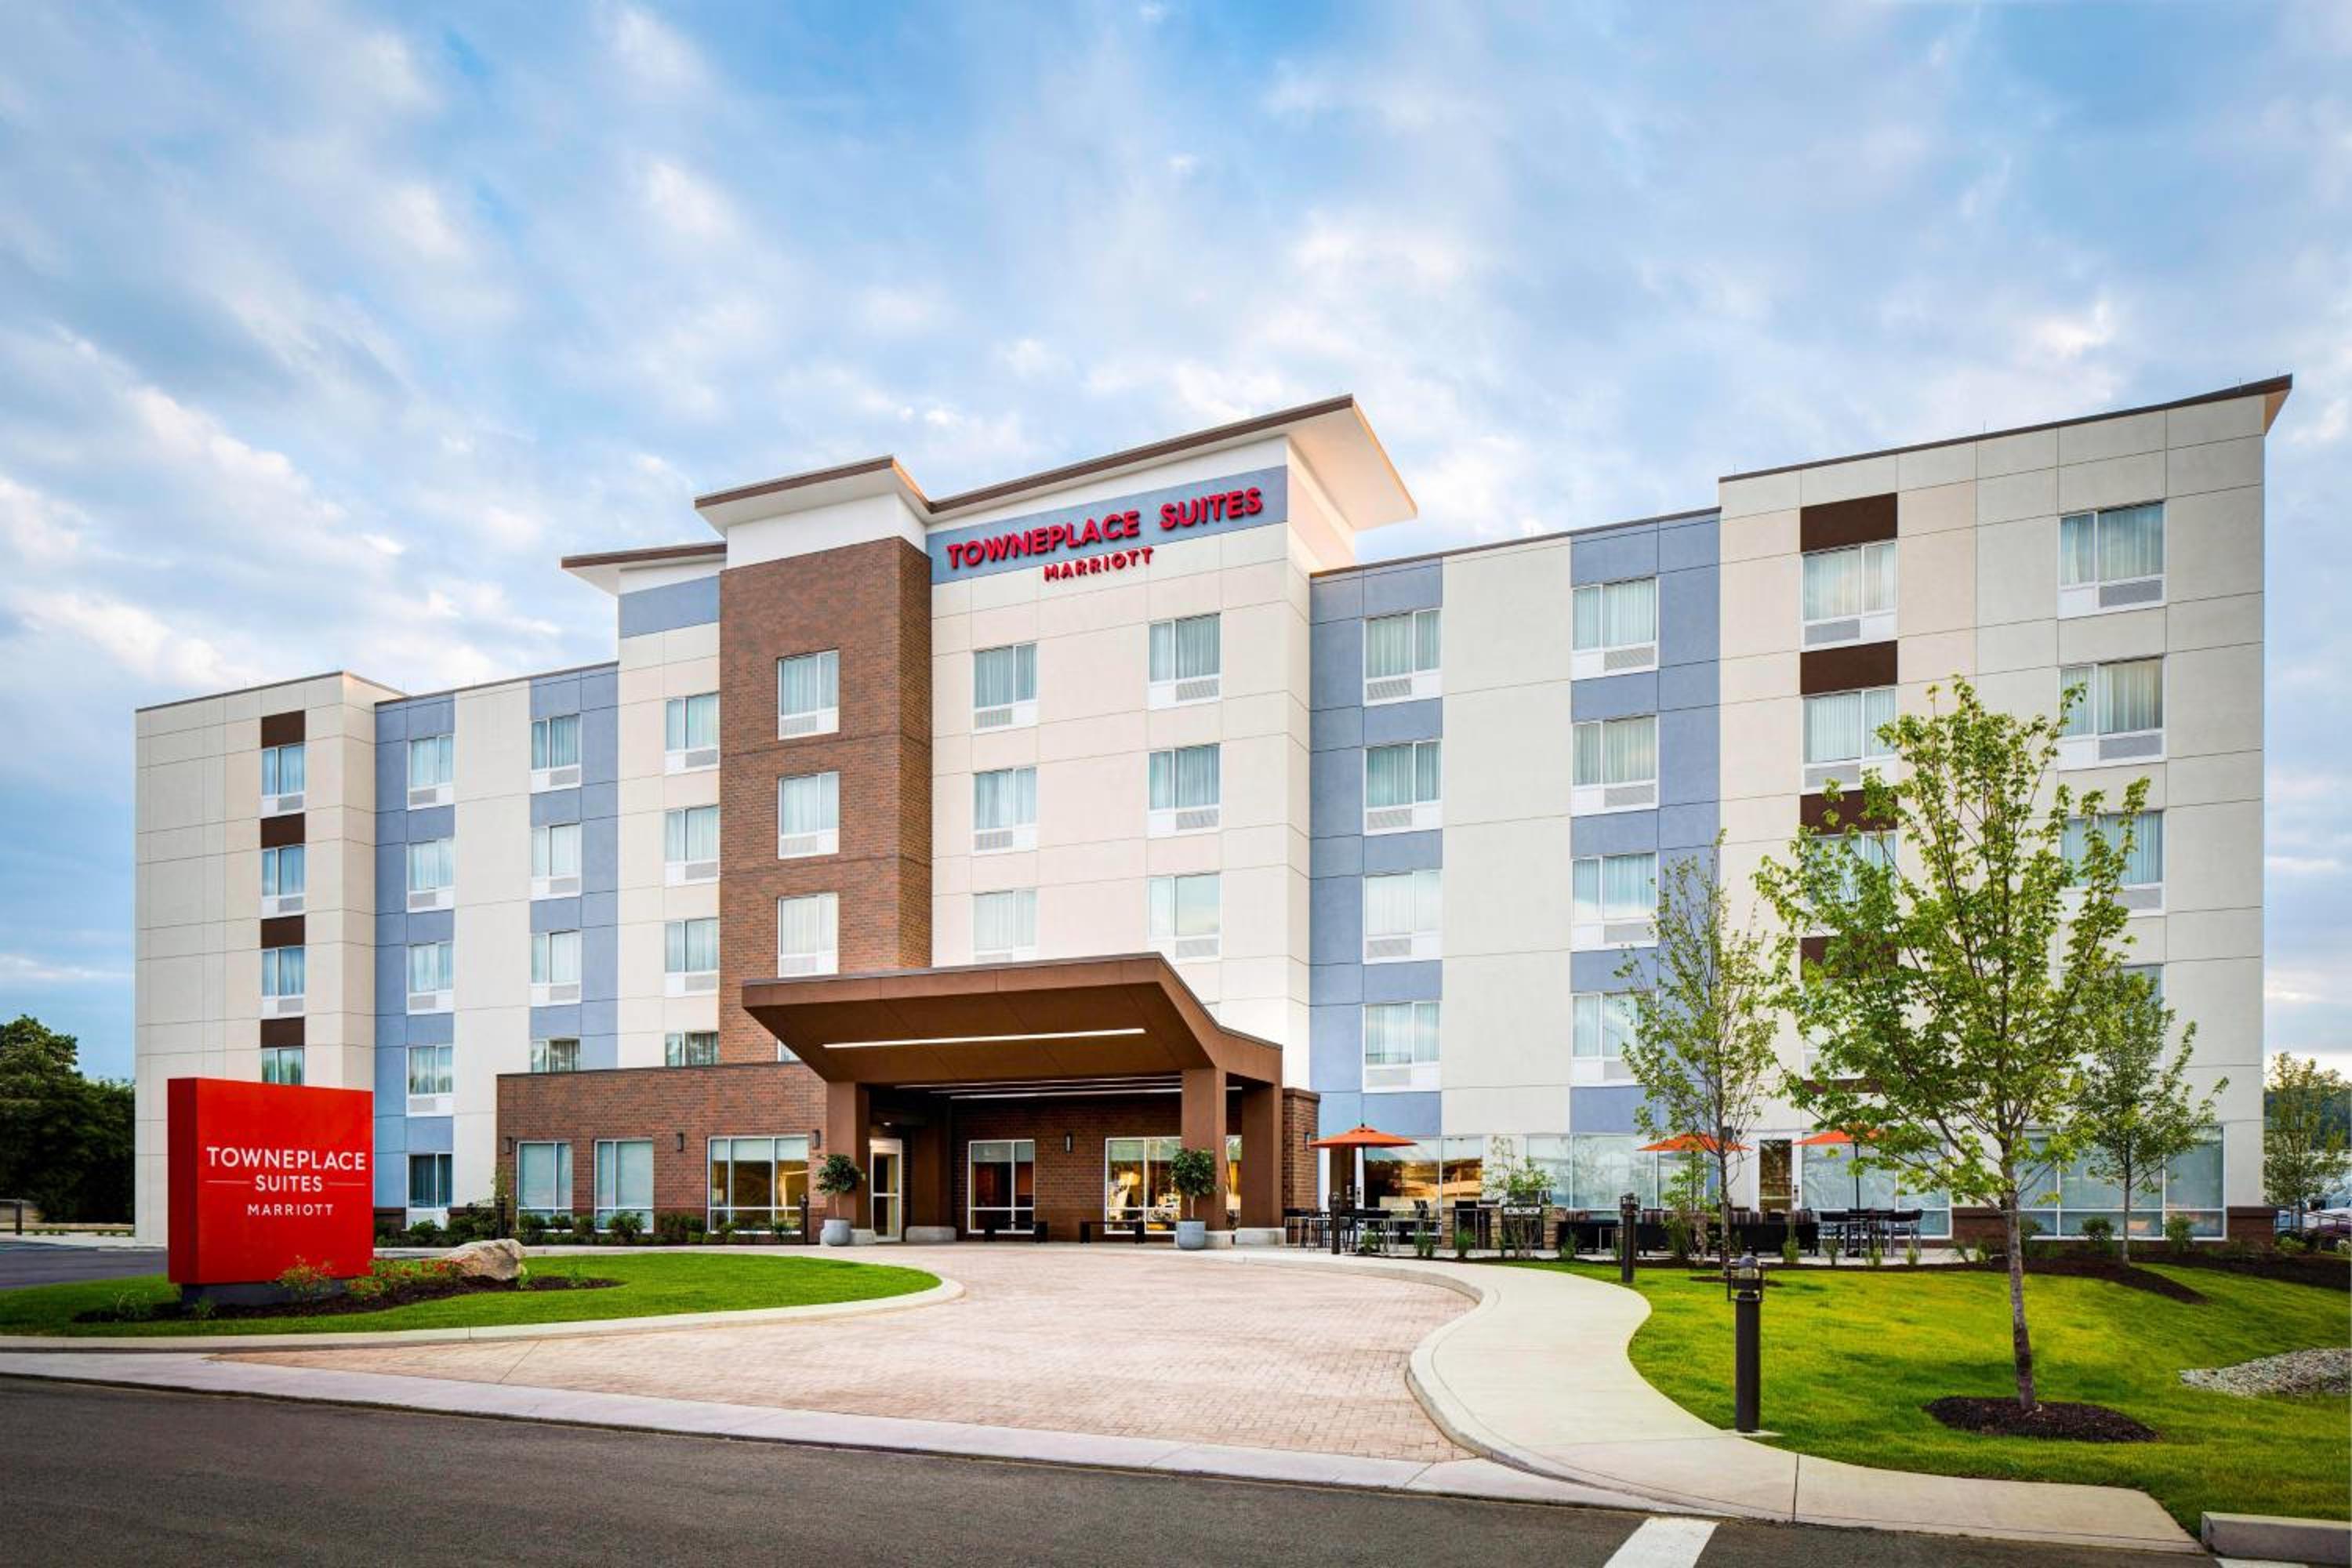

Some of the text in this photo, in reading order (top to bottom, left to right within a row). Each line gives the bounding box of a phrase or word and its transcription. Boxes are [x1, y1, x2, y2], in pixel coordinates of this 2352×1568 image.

[947, 487, 1263, 569] TOWNEPLACE SUITES
[1044, 547, 1154, 581] MARRIOTT
[206, 1146, 366, 1171] TOWNEPLACE
[255, 1174, 323, 1192] SUITES
[247, 1203, 334, 1216] MARRIOTT
